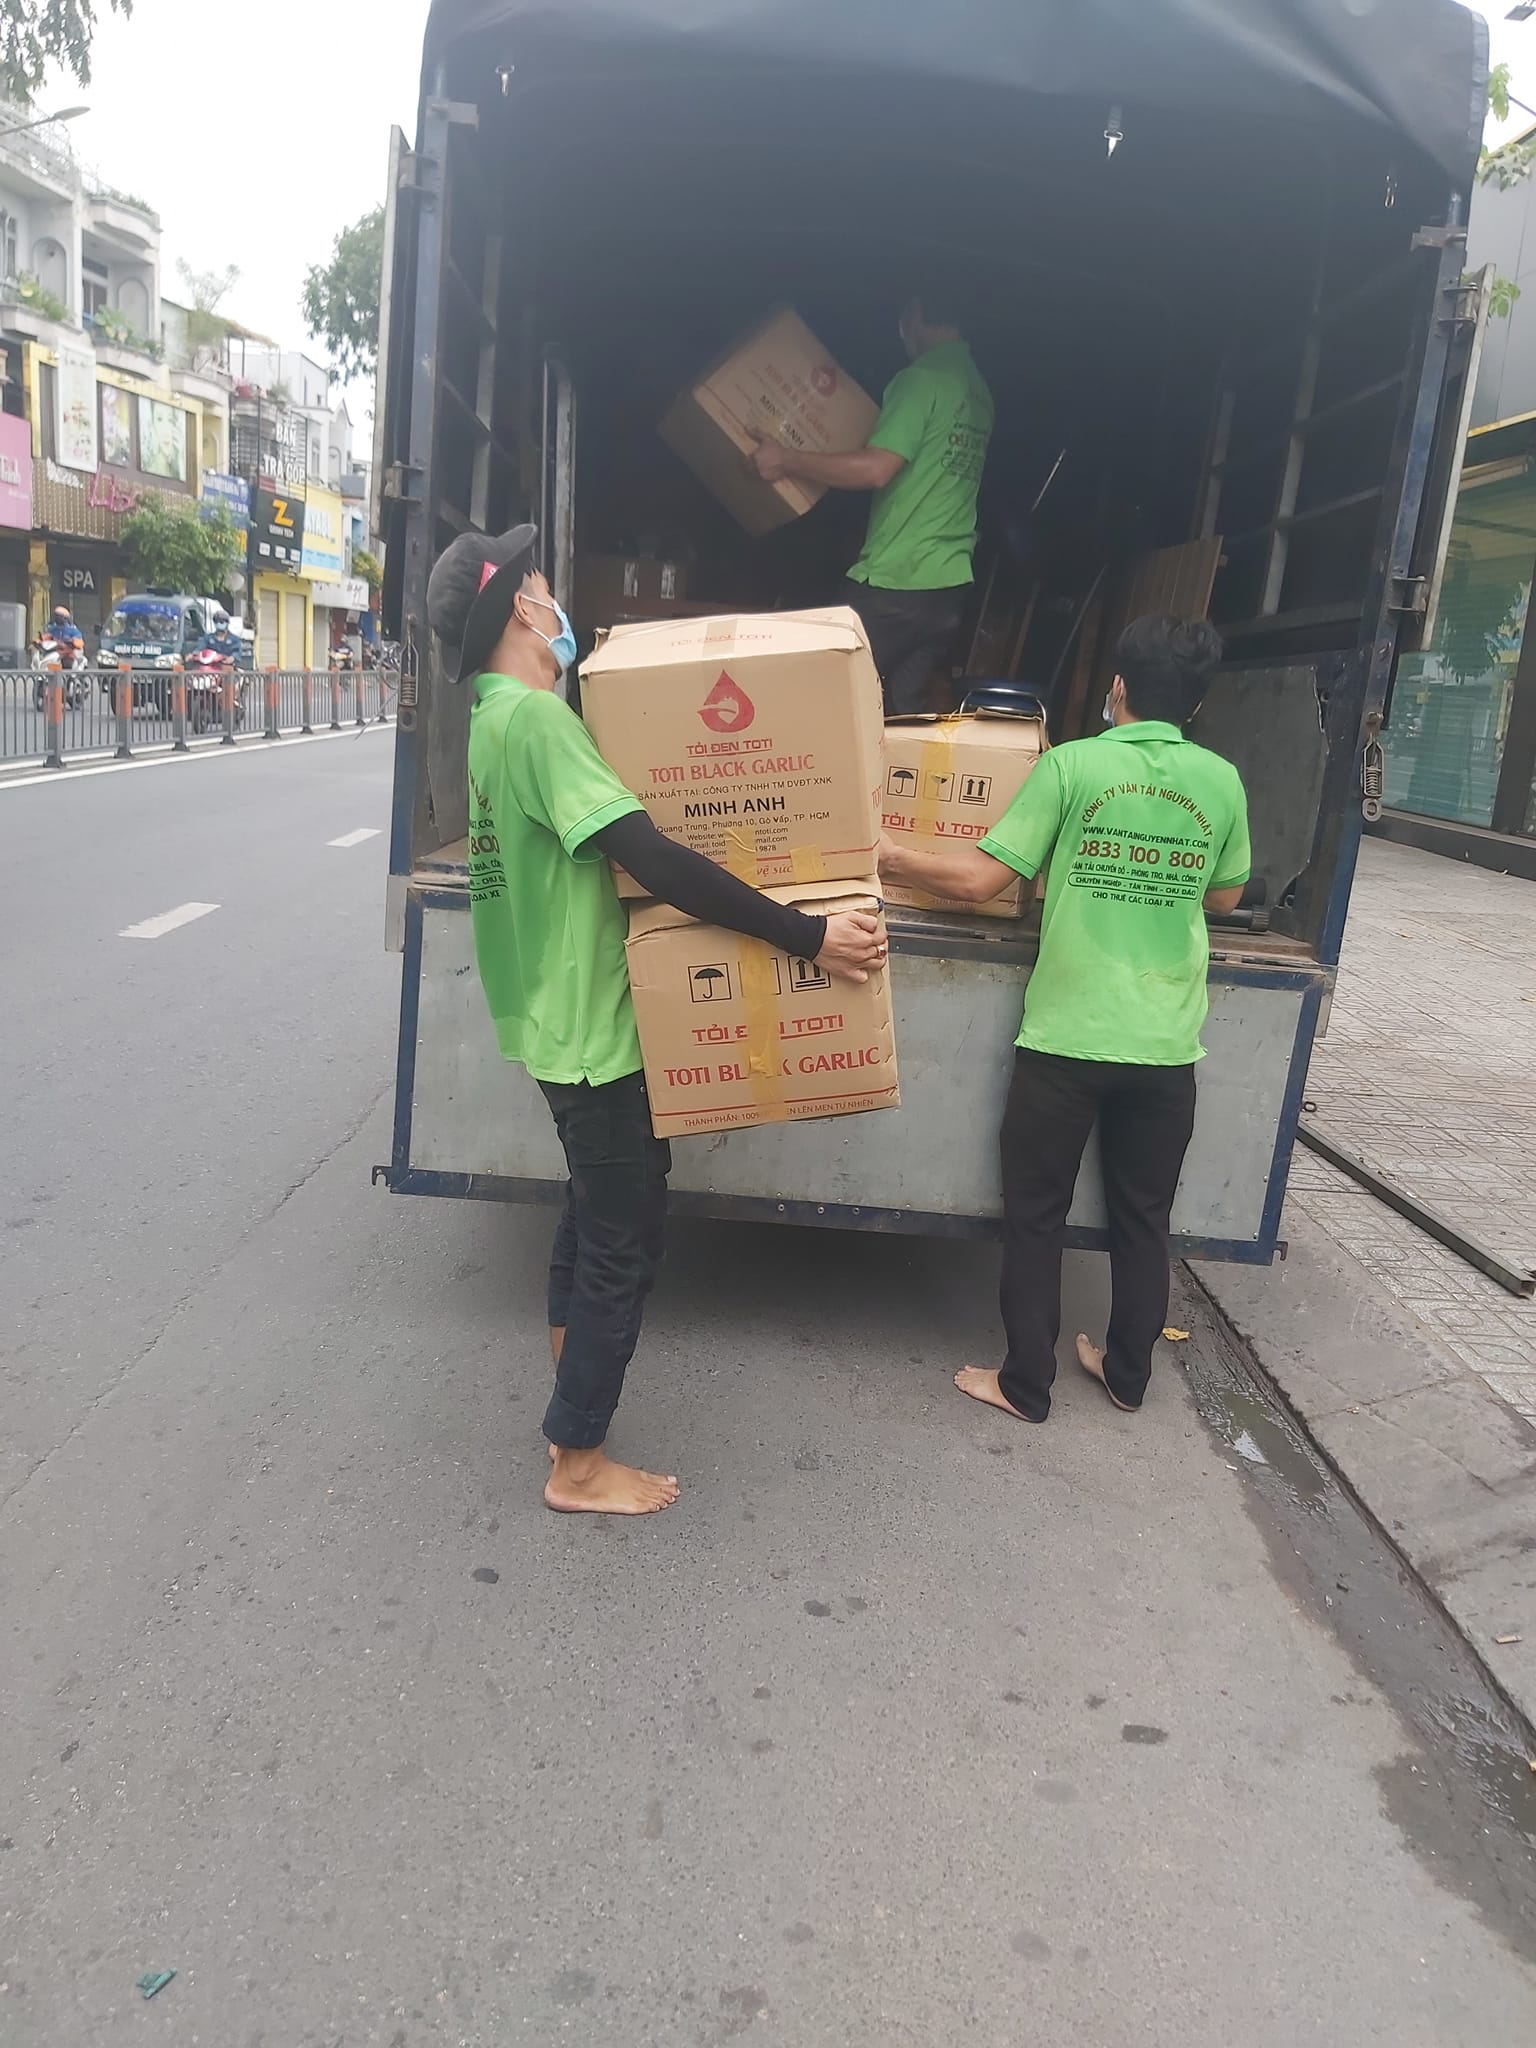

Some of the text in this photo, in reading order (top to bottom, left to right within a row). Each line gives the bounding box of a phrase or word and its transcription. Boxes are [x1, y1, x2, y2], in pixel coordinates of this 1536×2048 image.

[273, 499, 295, 527] Z
[63, 569, 95, 589] SPA
[686, 738, 773, 755] TỎI ĐEN TOTI
[648, 754, 815, 784] TOTI BLACK GARLIC
[703, 784, 729, 796] CÔNG
[732, 784, 743, 793] TY
[746, 782, 769, 792] TNHH
[772, 780, 785, 789] TM
[787, 778, 811, 788] DVĐT
[813, 776, 832, 785] XNK
[684, 796, 786, 819] MINH ANH
[1082, 797, 1104, 823] CÔNG
[1103, 786, 1115, 801] TY
[656, 825, 683, 834] Quang
[685, 823, 710, 833] Trung,
[759, 816, 771, 825] Gò
[810, 811, 831, 820] HCM
[882, 812, 905, 828] TỎI
[470, 834, 500, 857] 800
[1129, 845, 1160, 865] 100
[1168, 850, 1206, 870] 800
[757, 864, 793, 877] vệ sức
[489, 889, 502, 899] XE
[1092, 891, 1108, 900] CHO
[1165, 900, 1176, 908] XE
[692, 1023, 729, 1042] TỎI
[792, 1014, 844, 1033] TOTI
[664, 1066, 711, 1087] TOTI
[798, 1047, 881, 1074] GARLIC
[797, 1103, 813, 1114] LÊN
[814, 1103, 834, 1113] MEN
[848, 1098, 874, 1109] NHIÊN
